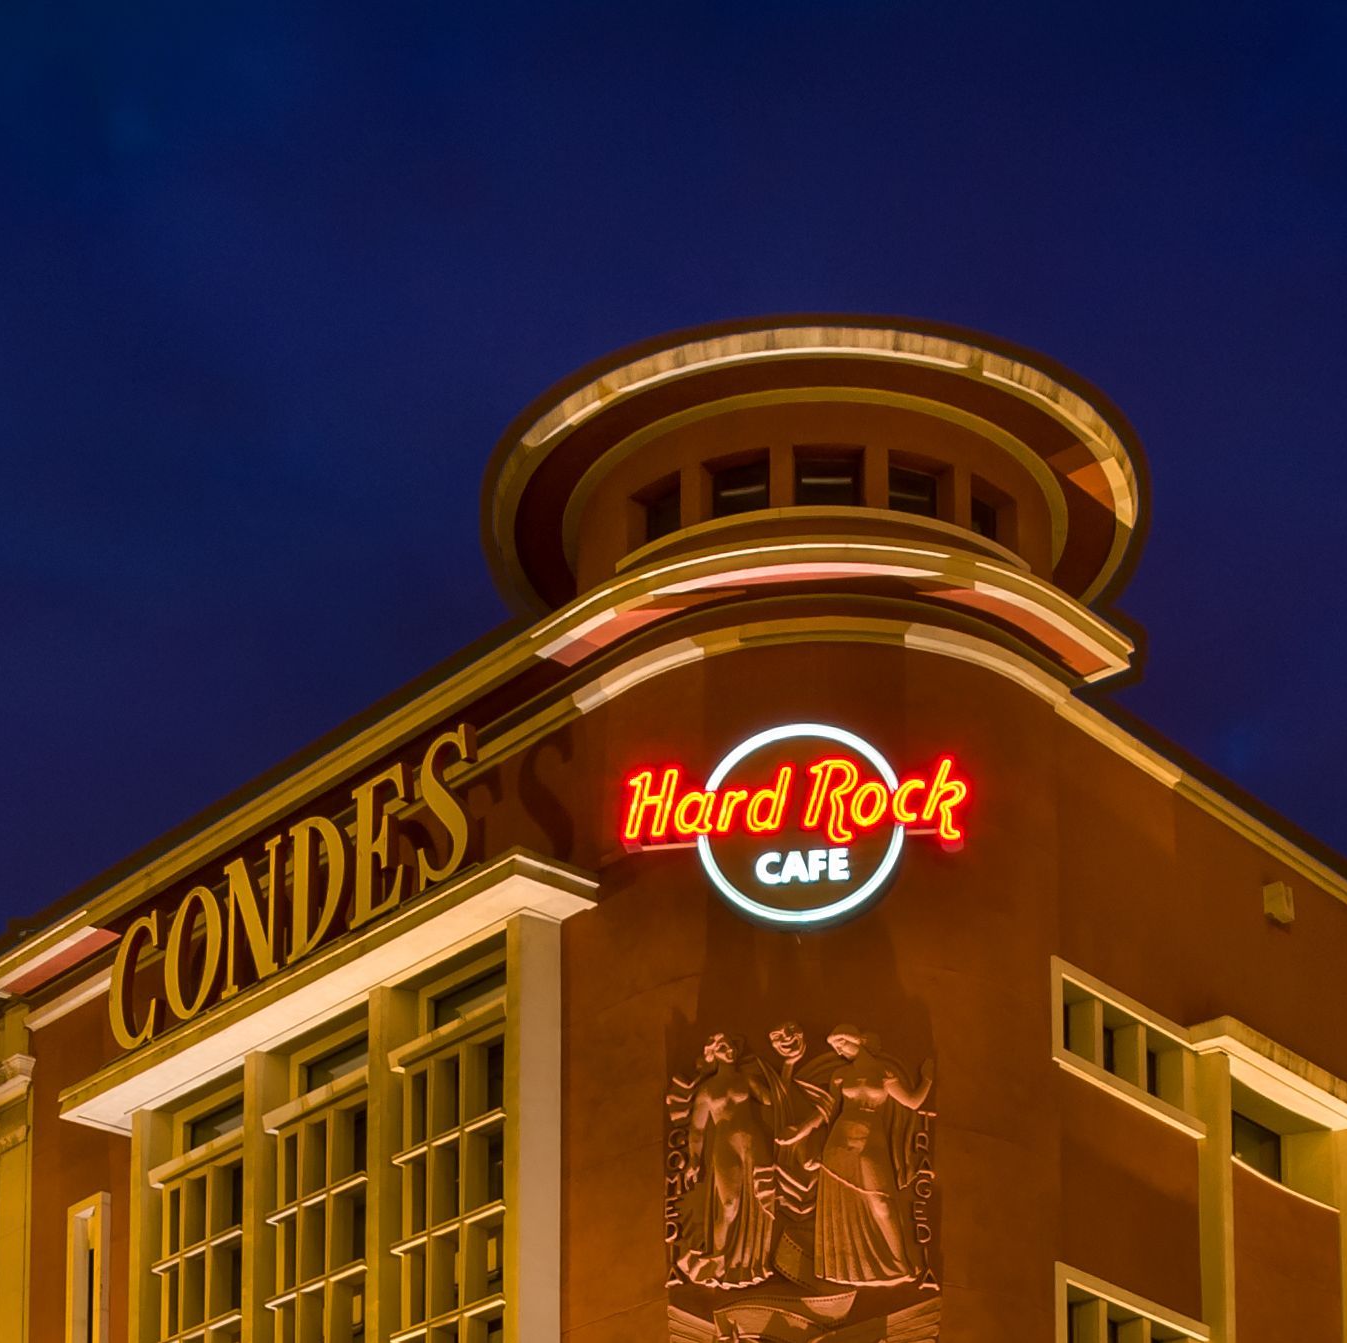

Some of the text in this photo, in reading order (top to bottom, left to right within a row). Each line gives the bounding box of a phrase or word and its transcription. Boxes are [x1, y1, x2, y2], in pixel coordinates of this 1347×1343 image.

[624, 757, 967, 843] Hard Rock
[755, 848, 850, 885] CAFE
[108, 723, 474, 1050] CONDES
[913, 1110, 940, 1291] TRAGEDIA
